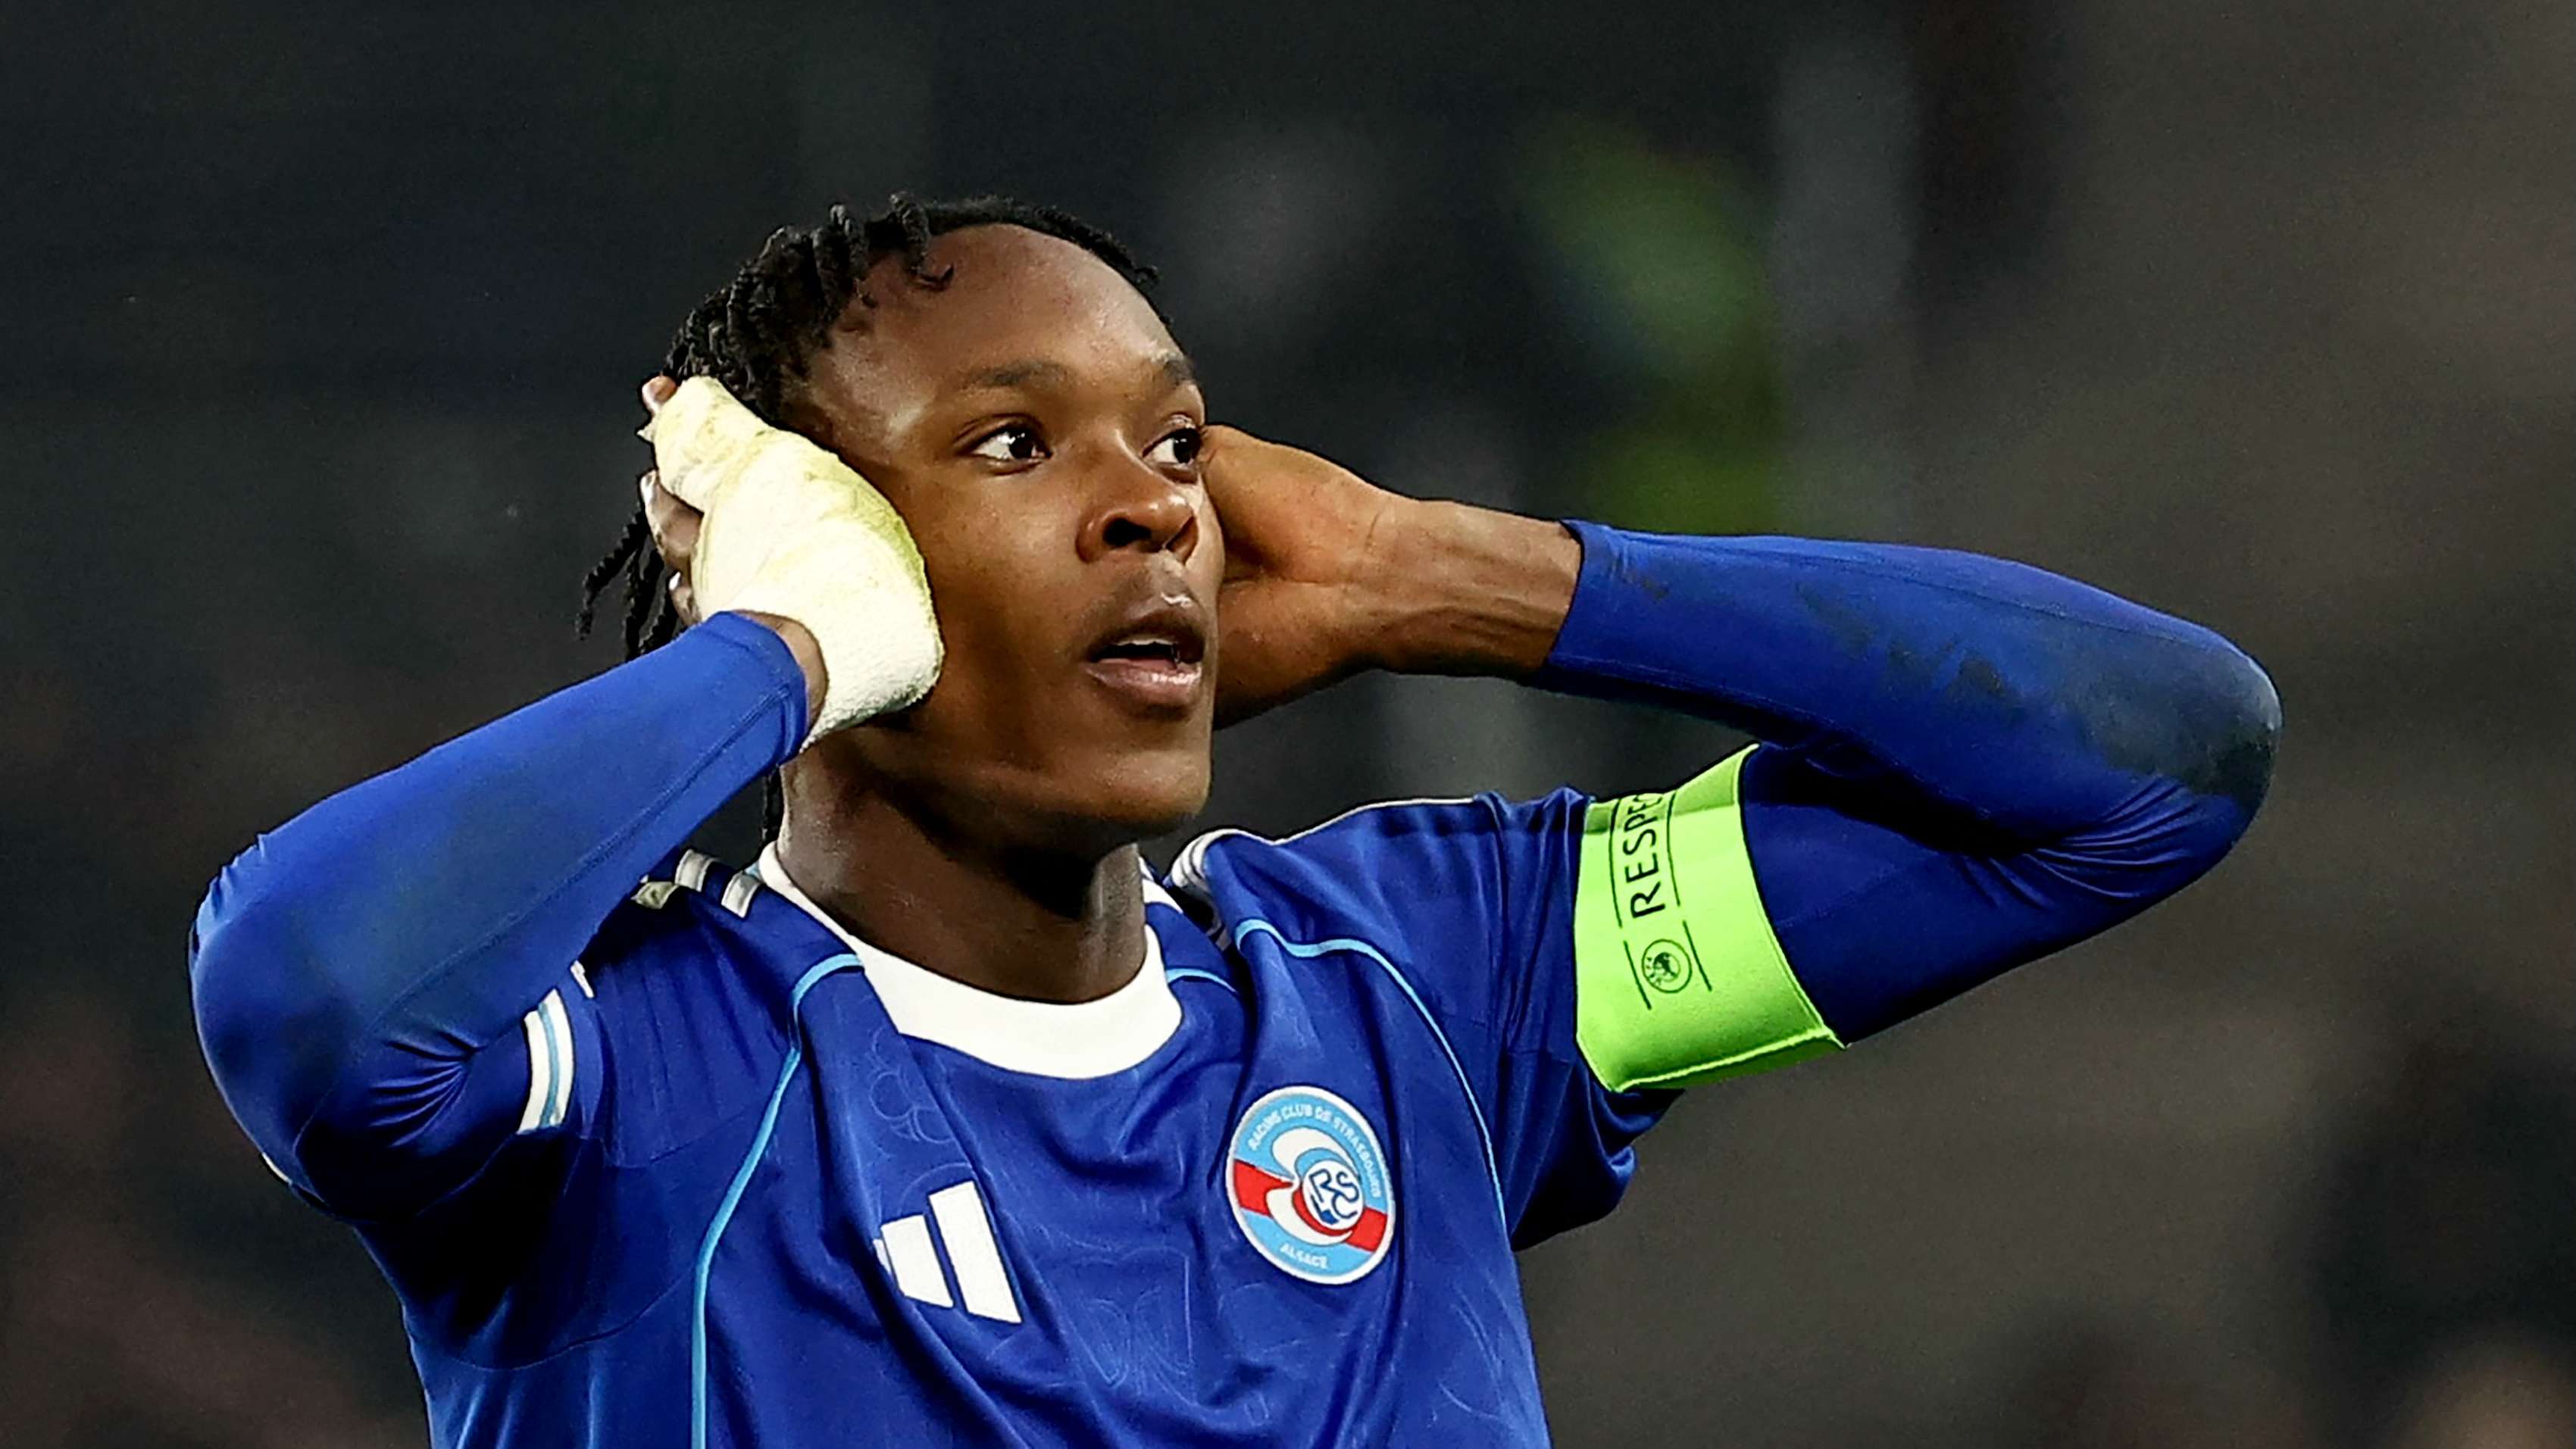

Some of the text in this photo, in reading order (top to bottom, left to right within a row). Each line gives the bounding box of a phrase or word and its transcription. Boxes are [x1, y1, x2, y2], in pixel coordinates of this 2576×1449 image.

[1622, 795, 1666, 919] RESPE
[1247, 1104, 1382, 1198] RACING CLUB DE STRASBOURG
[1280, 1242, 1328, 1269] ALSACE
